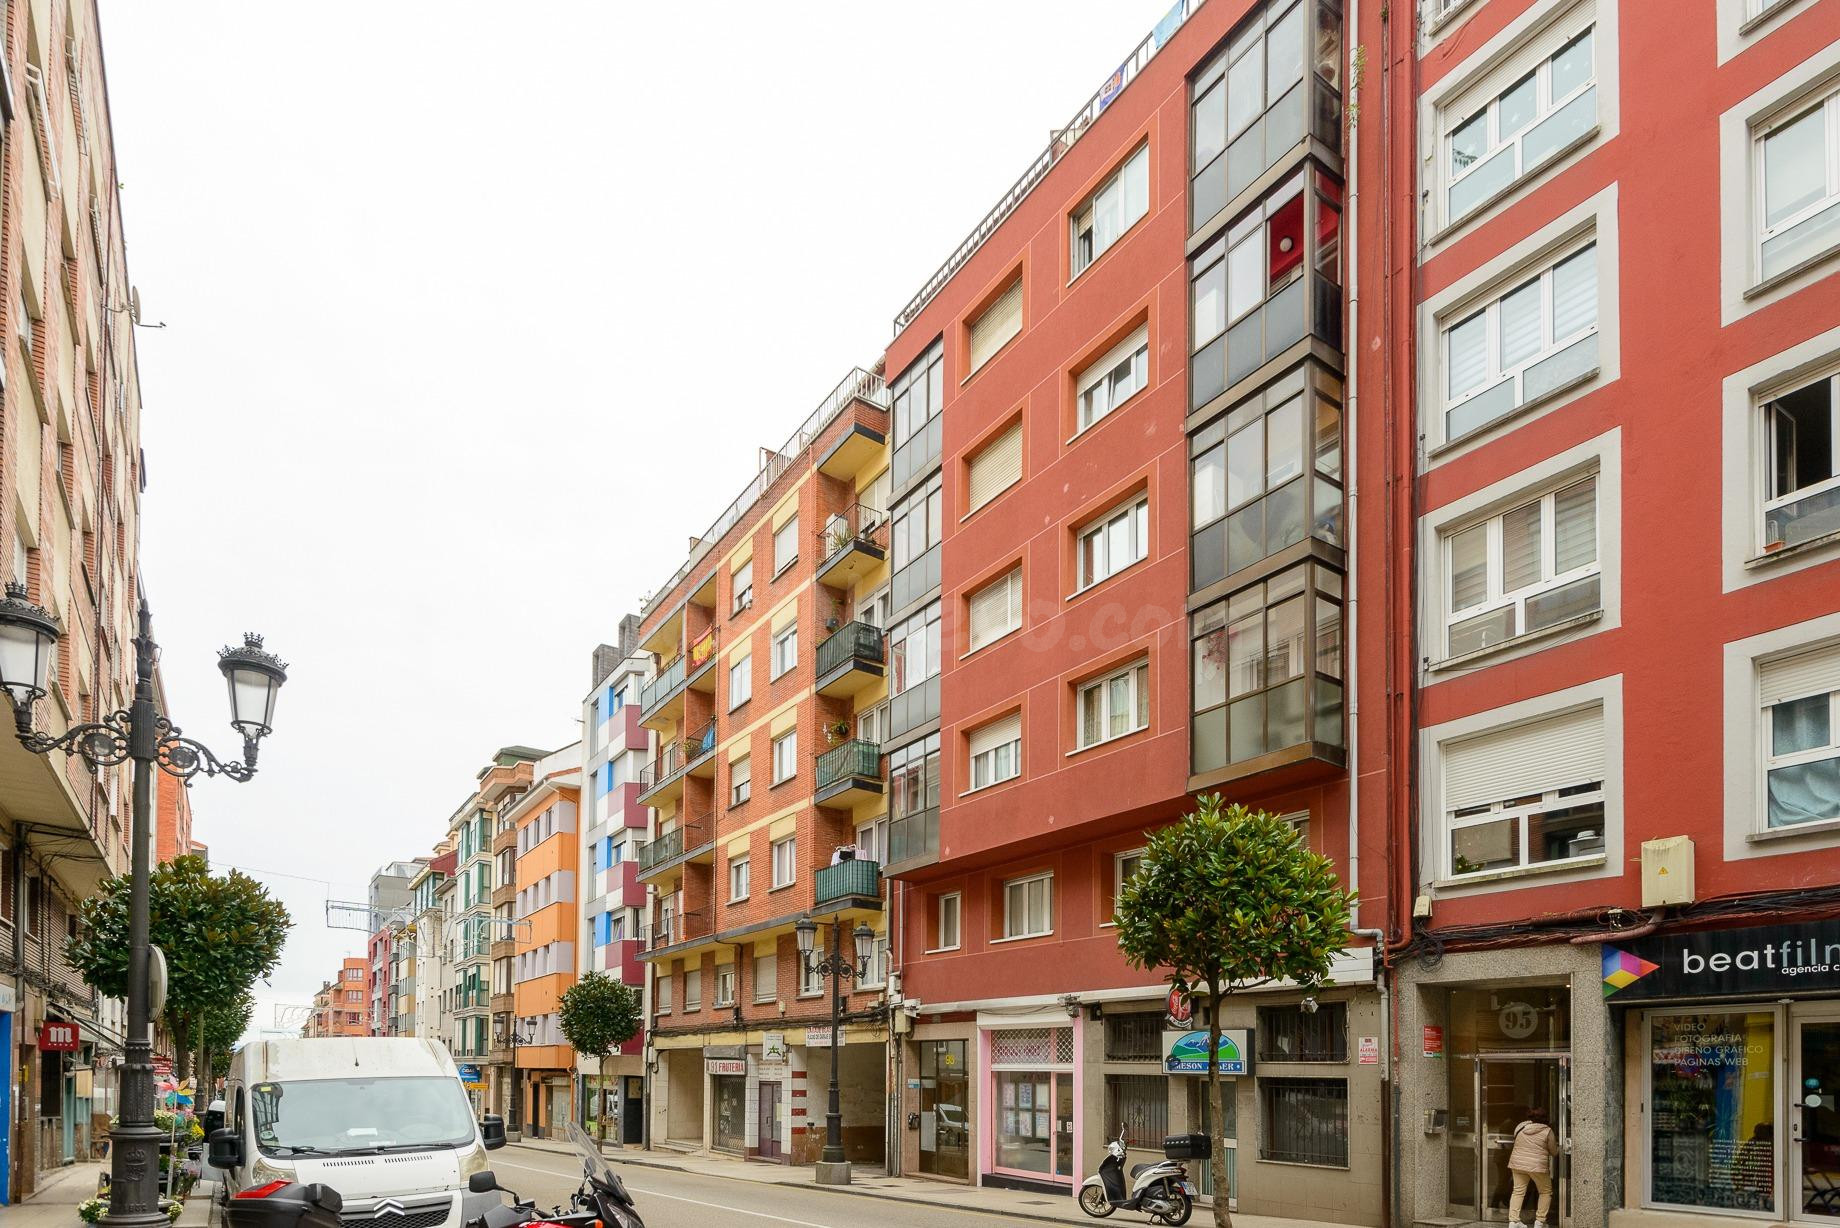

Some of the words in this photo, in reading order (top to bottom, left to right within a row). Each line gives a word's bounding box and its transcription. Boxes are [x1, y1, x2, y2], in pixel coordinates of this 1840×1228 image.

[1781, 963, 1829, 976] agencia
[1505, 1011, 1532, 1029] 95
[1724, 1057, 1749, 1066] WEB
